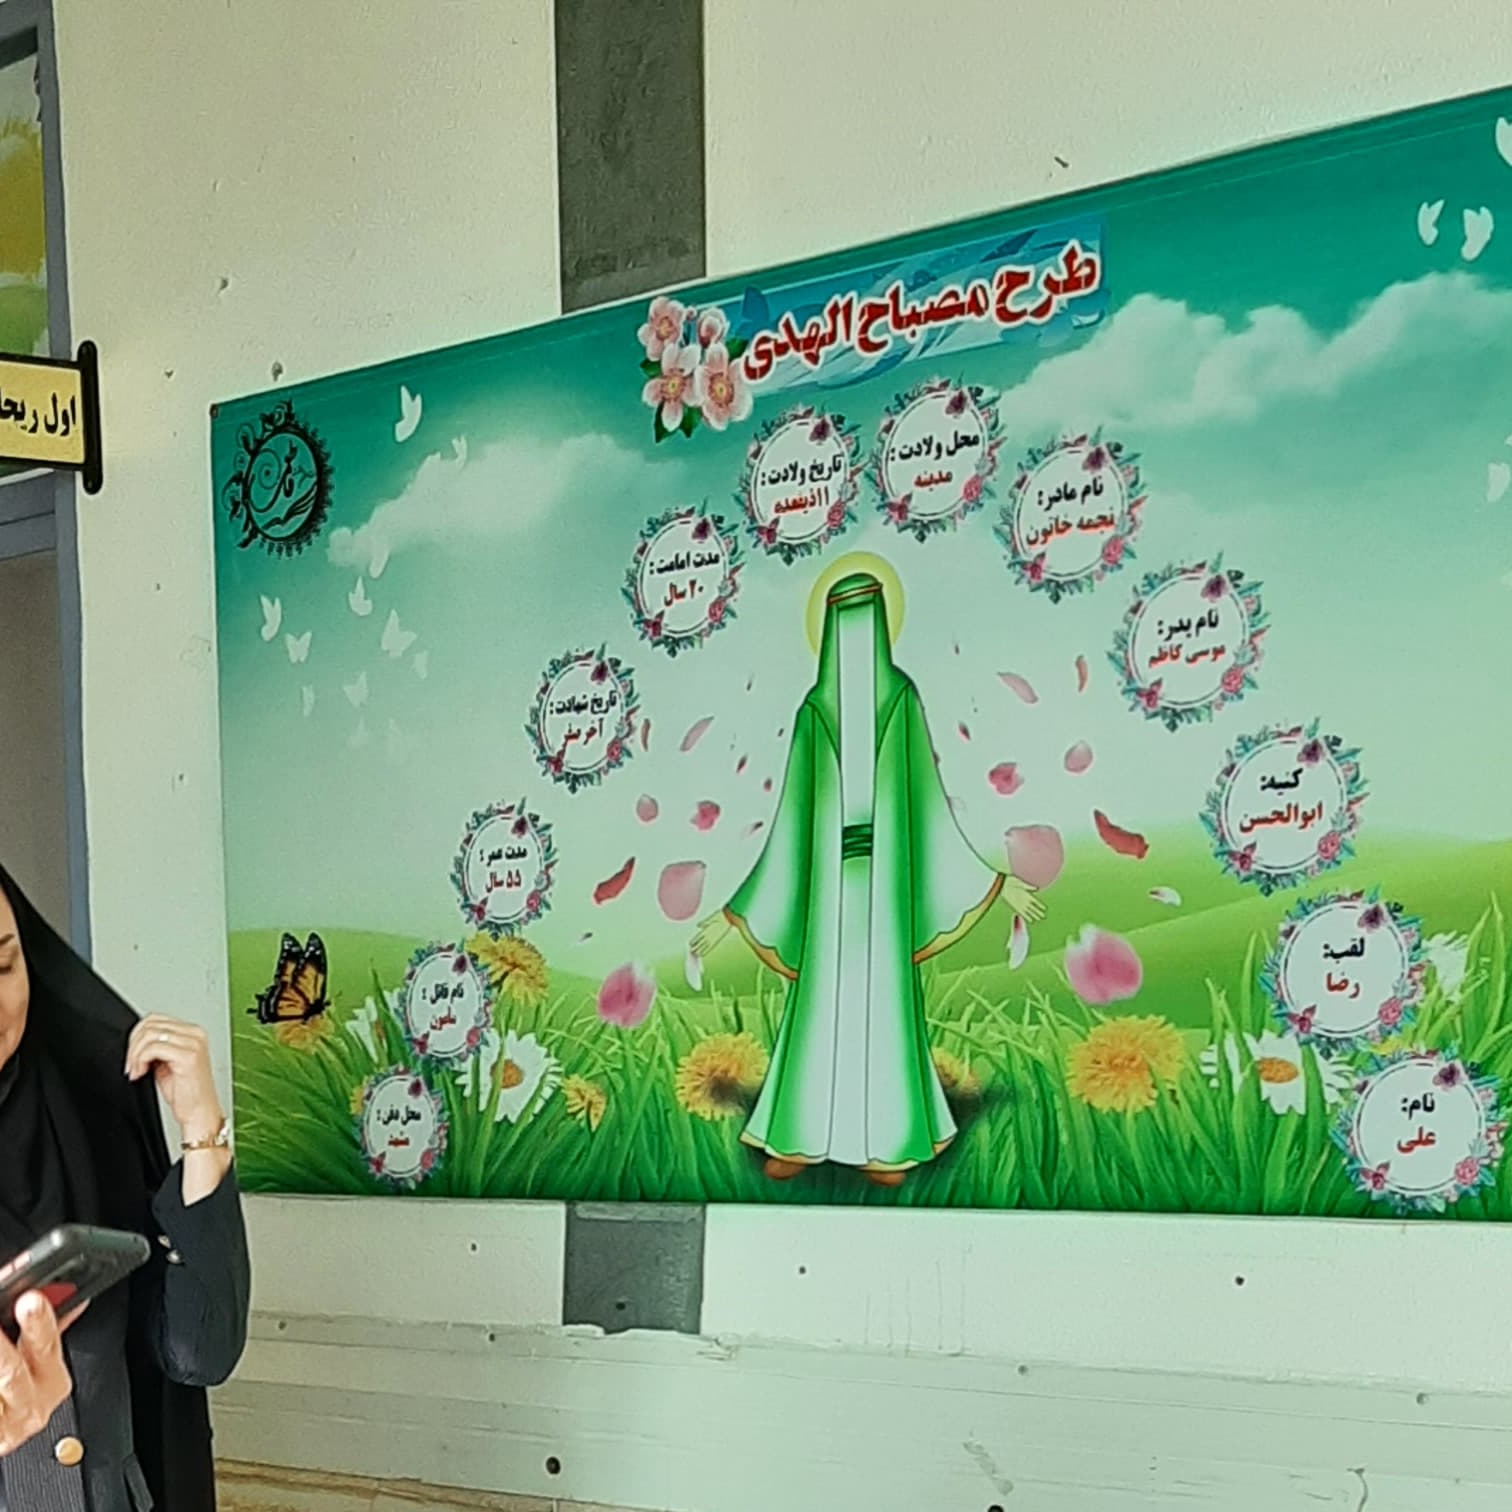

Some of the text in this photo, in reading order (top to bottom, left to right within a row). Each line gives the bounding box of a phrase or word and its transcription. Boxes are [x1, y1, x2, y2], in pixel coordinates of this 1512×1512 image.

[743, 243, 1099, 380] طرح مصباح الهدی
[44, 392, 77, 437] اول
[946, 430, 980, 456] محل
[809, 453, 844, 482] تاریخ
[913, 470, 953, 491] مدینه
[1081, 476, 1104, 504] نام
[1026, 508, 1116, 546] نجمه خاتون
[693, 551, 720, 569] مدت
[664, 582, 687, 607] سال
[1195, 608, 1219, 637] نام
[1148, 644, 1226, 668] موسی کاظم
[590, 690, 617, 715] تاریخ
[1238, 801, 1323, 833] ابوالحسن
[505, 846, 528, 860] مدت
[485, 869, 522, 893] ۵۵ سال
[450, 982, 464, 1004] نام
[1325, 971, 1360, 998] رضا
[401, 1104, 421, 1126] محل
[1397, 1126, 1436, 1153] علی
